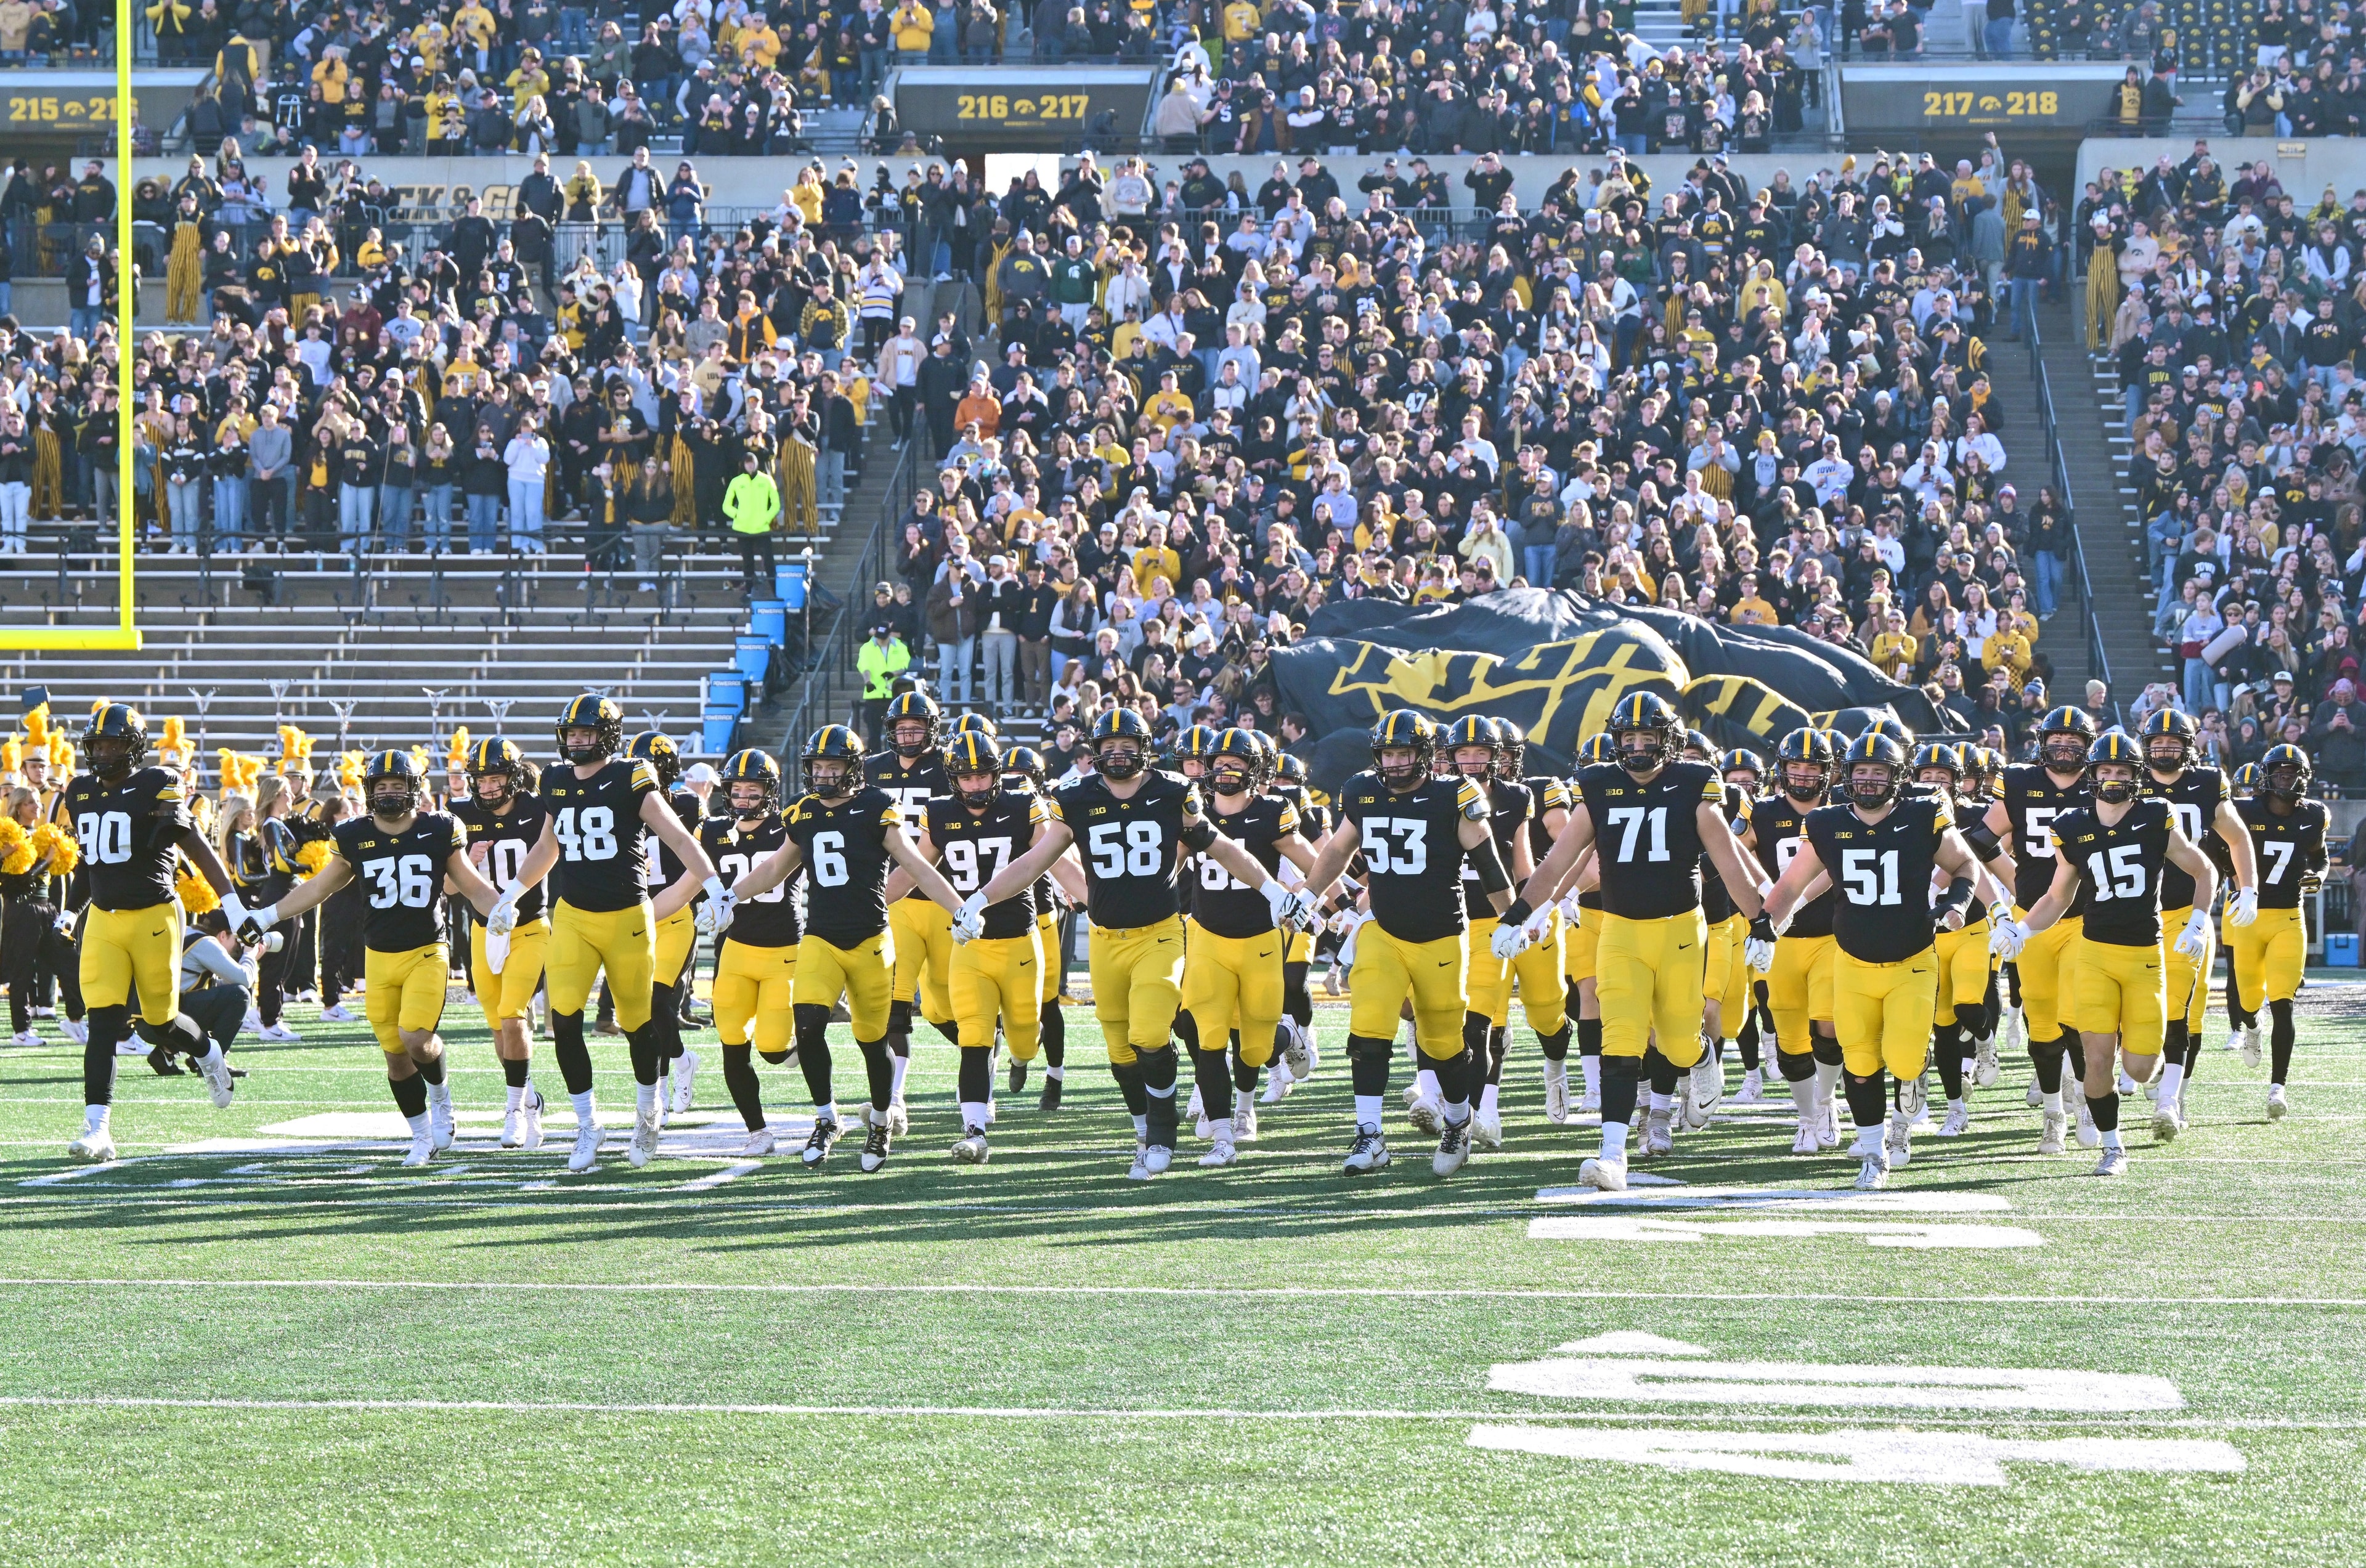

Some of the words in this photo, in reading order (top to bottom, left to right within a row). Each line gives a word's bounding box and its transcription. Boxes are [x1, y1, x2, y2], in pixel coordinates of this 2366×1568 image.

[9, 97, 59, 121] 215
[957, 95, 1008, 118] 216
[1040, 95, 1089, 118] 217
[1924, 92, 1974, 115] 217
[2007, 92, 2058, 115] 218
[497, 272, 510, 292] 3
[1875, 290, 1899, 300] IOWA
[2312, 325, 2339, 335] IOWA
[1404, 392, 1428, 413] 47
[2149, 371, 2169, 384] IOWA
[78, 811, 132, 865] 90
[553, 806, 618, 862] 48
[813, 831, 850, 887] 6
[1089, 821, 1163, 879] 58
[1361, 817, 1427, 875] 53
[1607, 806, 1670, 863] 71
[2026, 807, 2078, 858] 5
[363, 854, 433, 909] 36
[479, 839, 528, 891] 10
[945, 836, 1012, 891] 97
[1194, 837, 1251, 891] 81
[1842, 849, 1901, 906] 51
[2088, 843, 2145, 903] 15
[2263, 840, 2295, 885] 7
